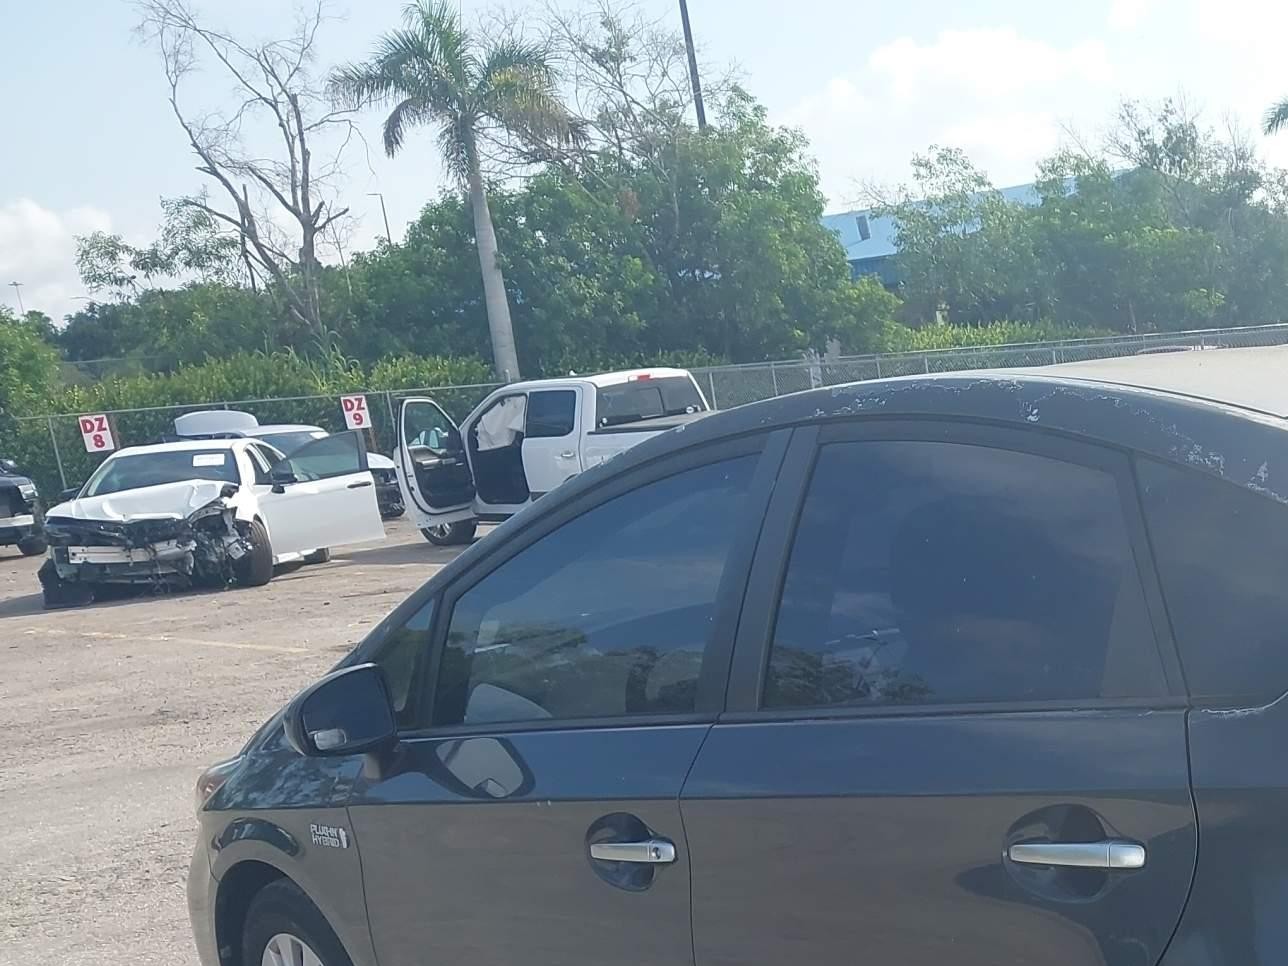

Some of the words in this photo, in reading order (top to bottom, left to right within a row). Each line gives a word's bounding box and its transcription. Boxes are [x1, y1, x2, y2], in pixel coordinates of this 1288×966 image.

[342, 397, 365, 412] DZ
[80, 416, 107, 433] DZ
[352, 412, 364, 426] 9
[92, 433, 106, 448] 8
